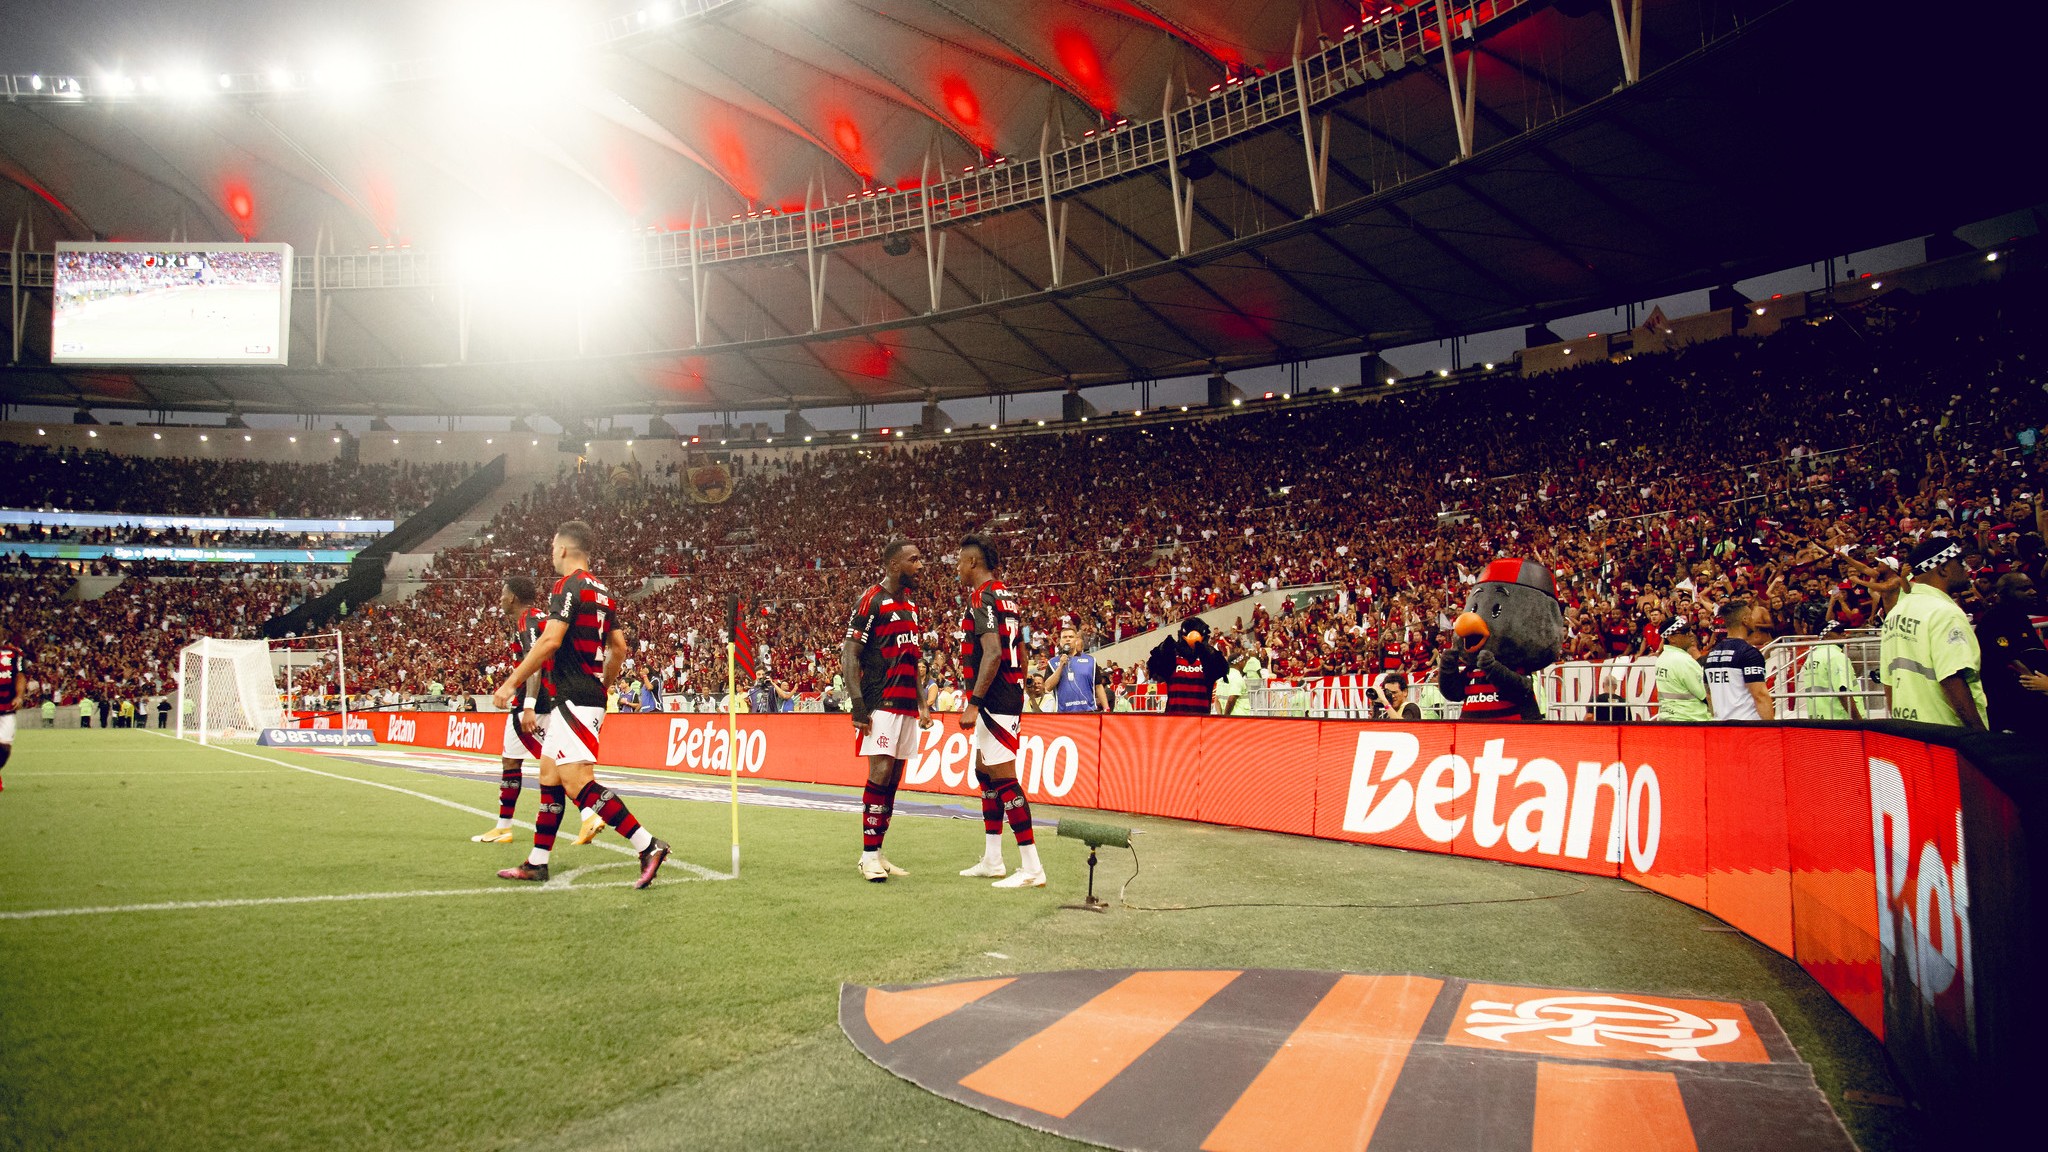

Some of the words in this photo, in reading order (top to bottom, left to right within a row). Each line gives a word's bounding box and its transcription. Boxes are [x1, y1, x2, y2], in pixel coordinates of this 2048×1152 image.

[387, 714, 416, 743] Betano
[446, 715, 485, 750] Betano
[665, 718, 767, 773] Betano
[905, 719, 1079, 798] Betno
[1342, 731, 1662, 873] Betano
